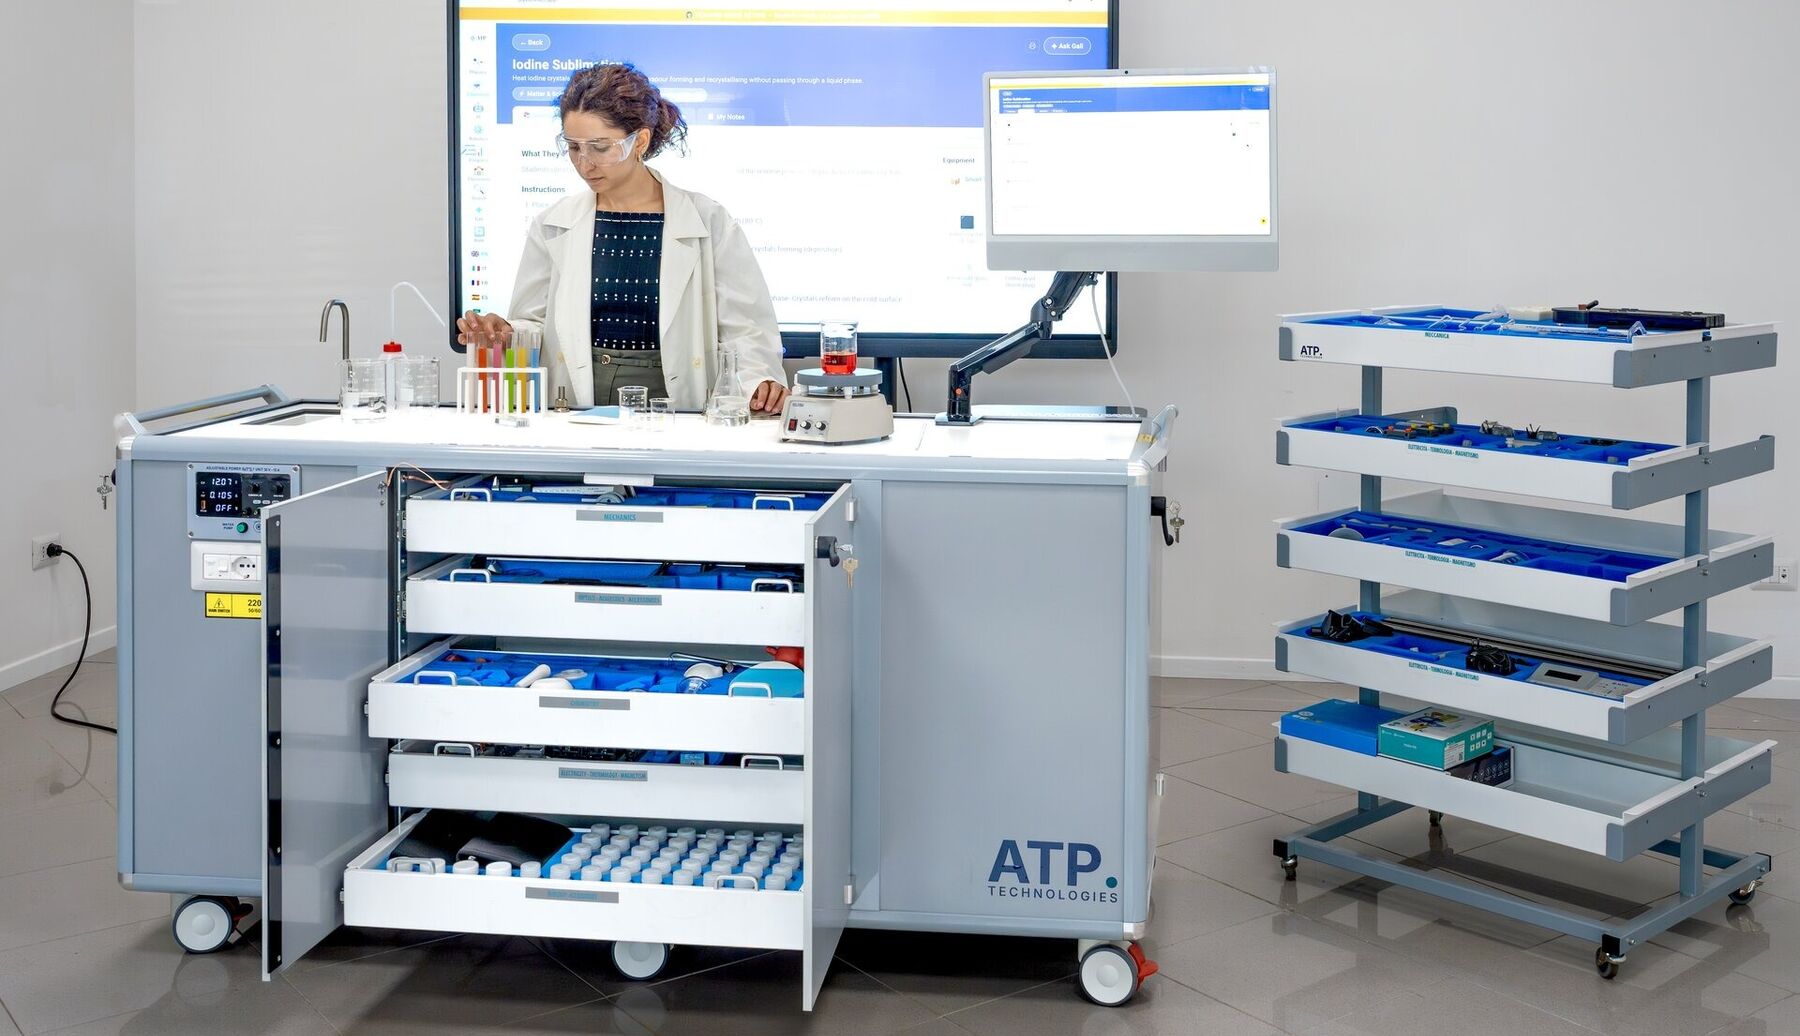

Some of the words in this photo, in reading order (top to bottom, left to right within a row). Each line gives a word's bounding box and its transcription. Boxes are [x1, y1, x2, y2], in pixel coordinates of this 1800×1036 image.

[512, 59, 549, 70] Iodine
[542, 150, 560, 159] They
[1300, 345, 1322, 356] ATP.
[215, 504, 232, 512] OFF
[988, 839, 1118, 889] ATP.
[988, 885, 1118, 904] TECHNOLOGIES
